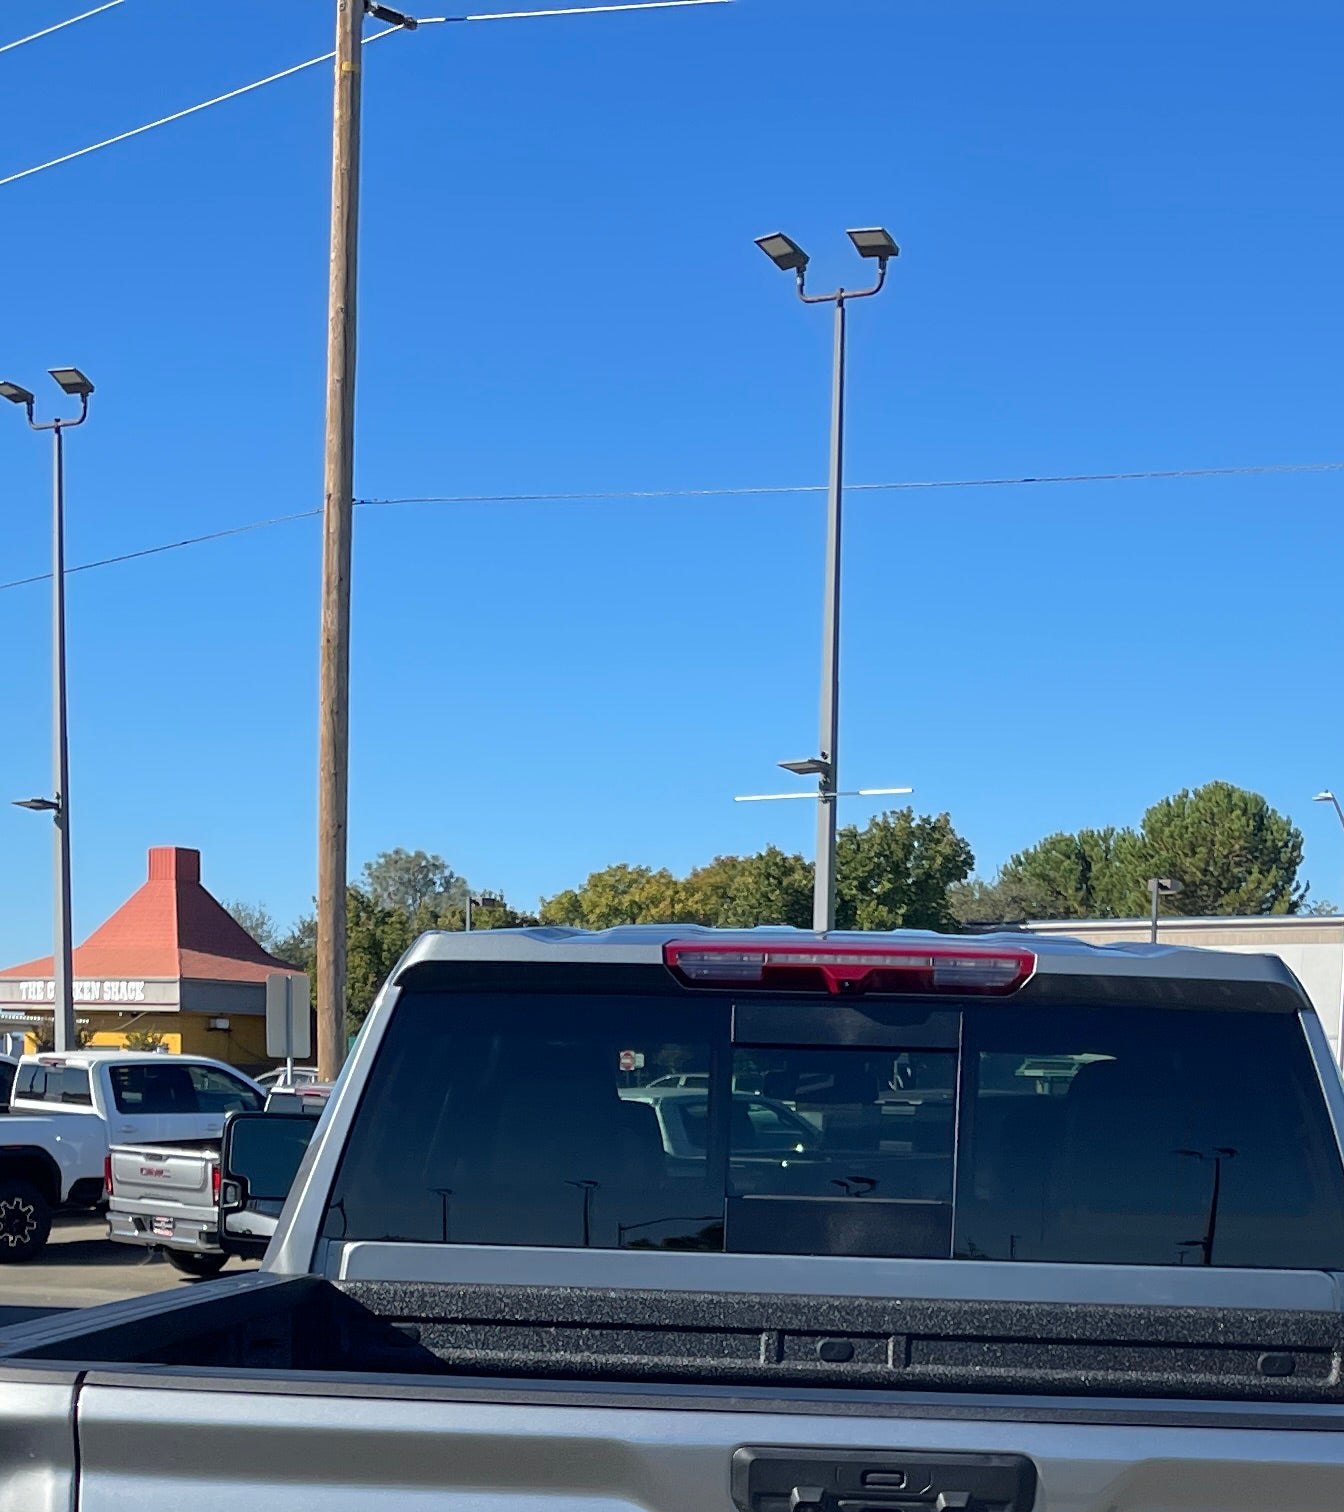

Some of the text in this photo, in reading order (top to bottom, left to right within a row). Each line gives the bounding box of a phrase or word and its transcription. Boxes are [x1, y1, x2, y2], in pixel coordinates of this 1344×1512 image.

[20, 981, 145, 1000] THE CKEN SHACK
